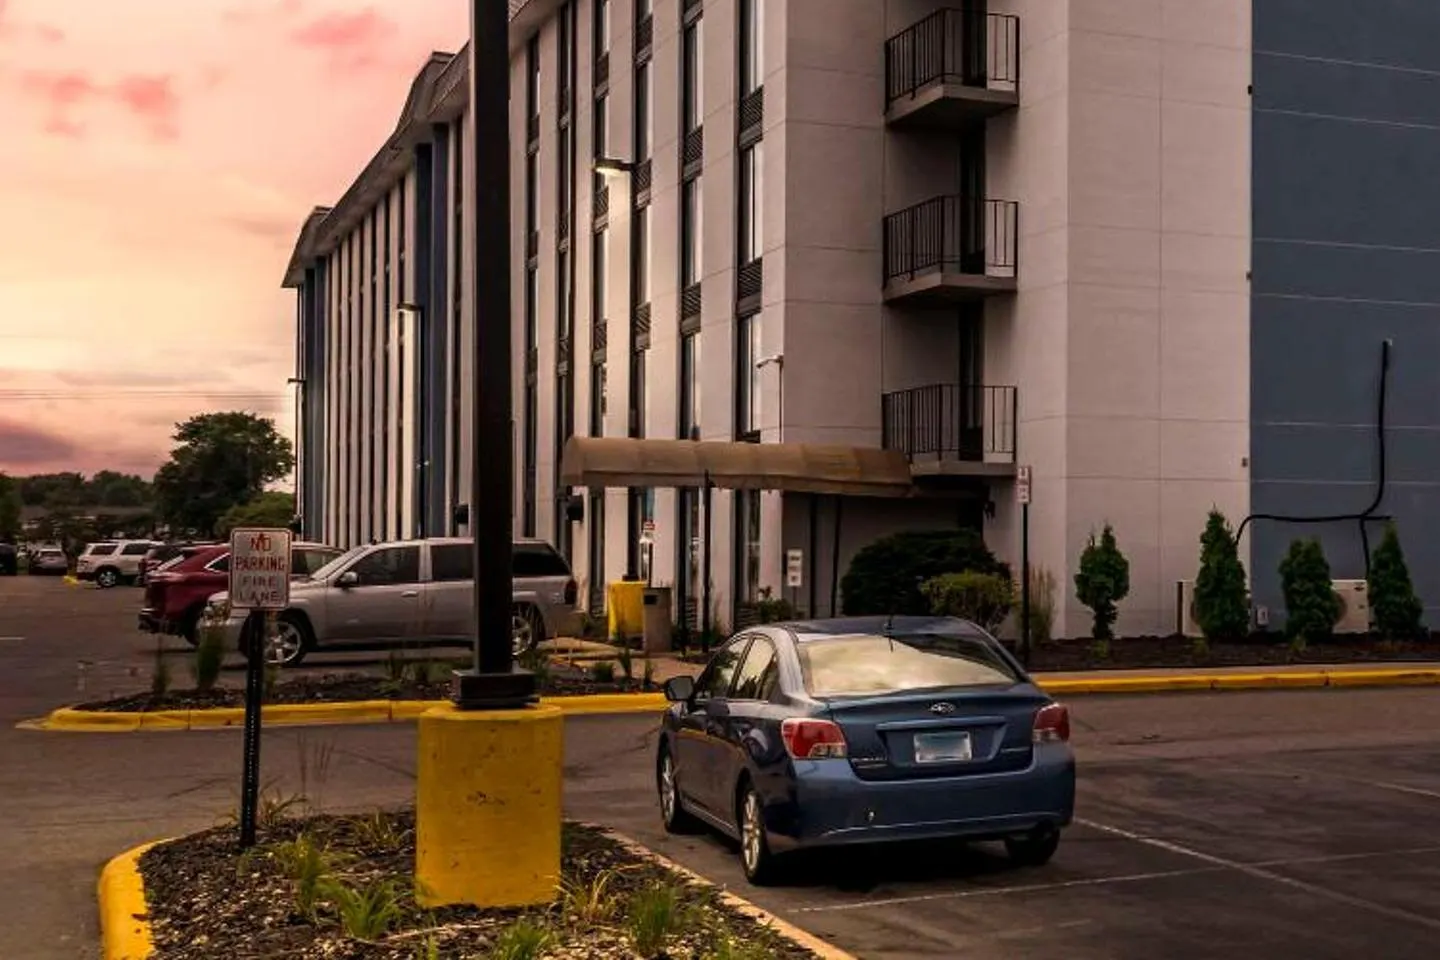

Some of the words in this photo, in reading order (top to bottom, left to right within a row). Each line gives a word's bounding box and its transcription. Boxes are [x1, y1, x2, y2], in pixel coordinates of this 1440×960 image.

[250, 534, 272, 551] NO
[235, 555, 285, 571] PARKING
[242, 575, 277, 587] FIRE
[239, 590, 279, 602] LANE
